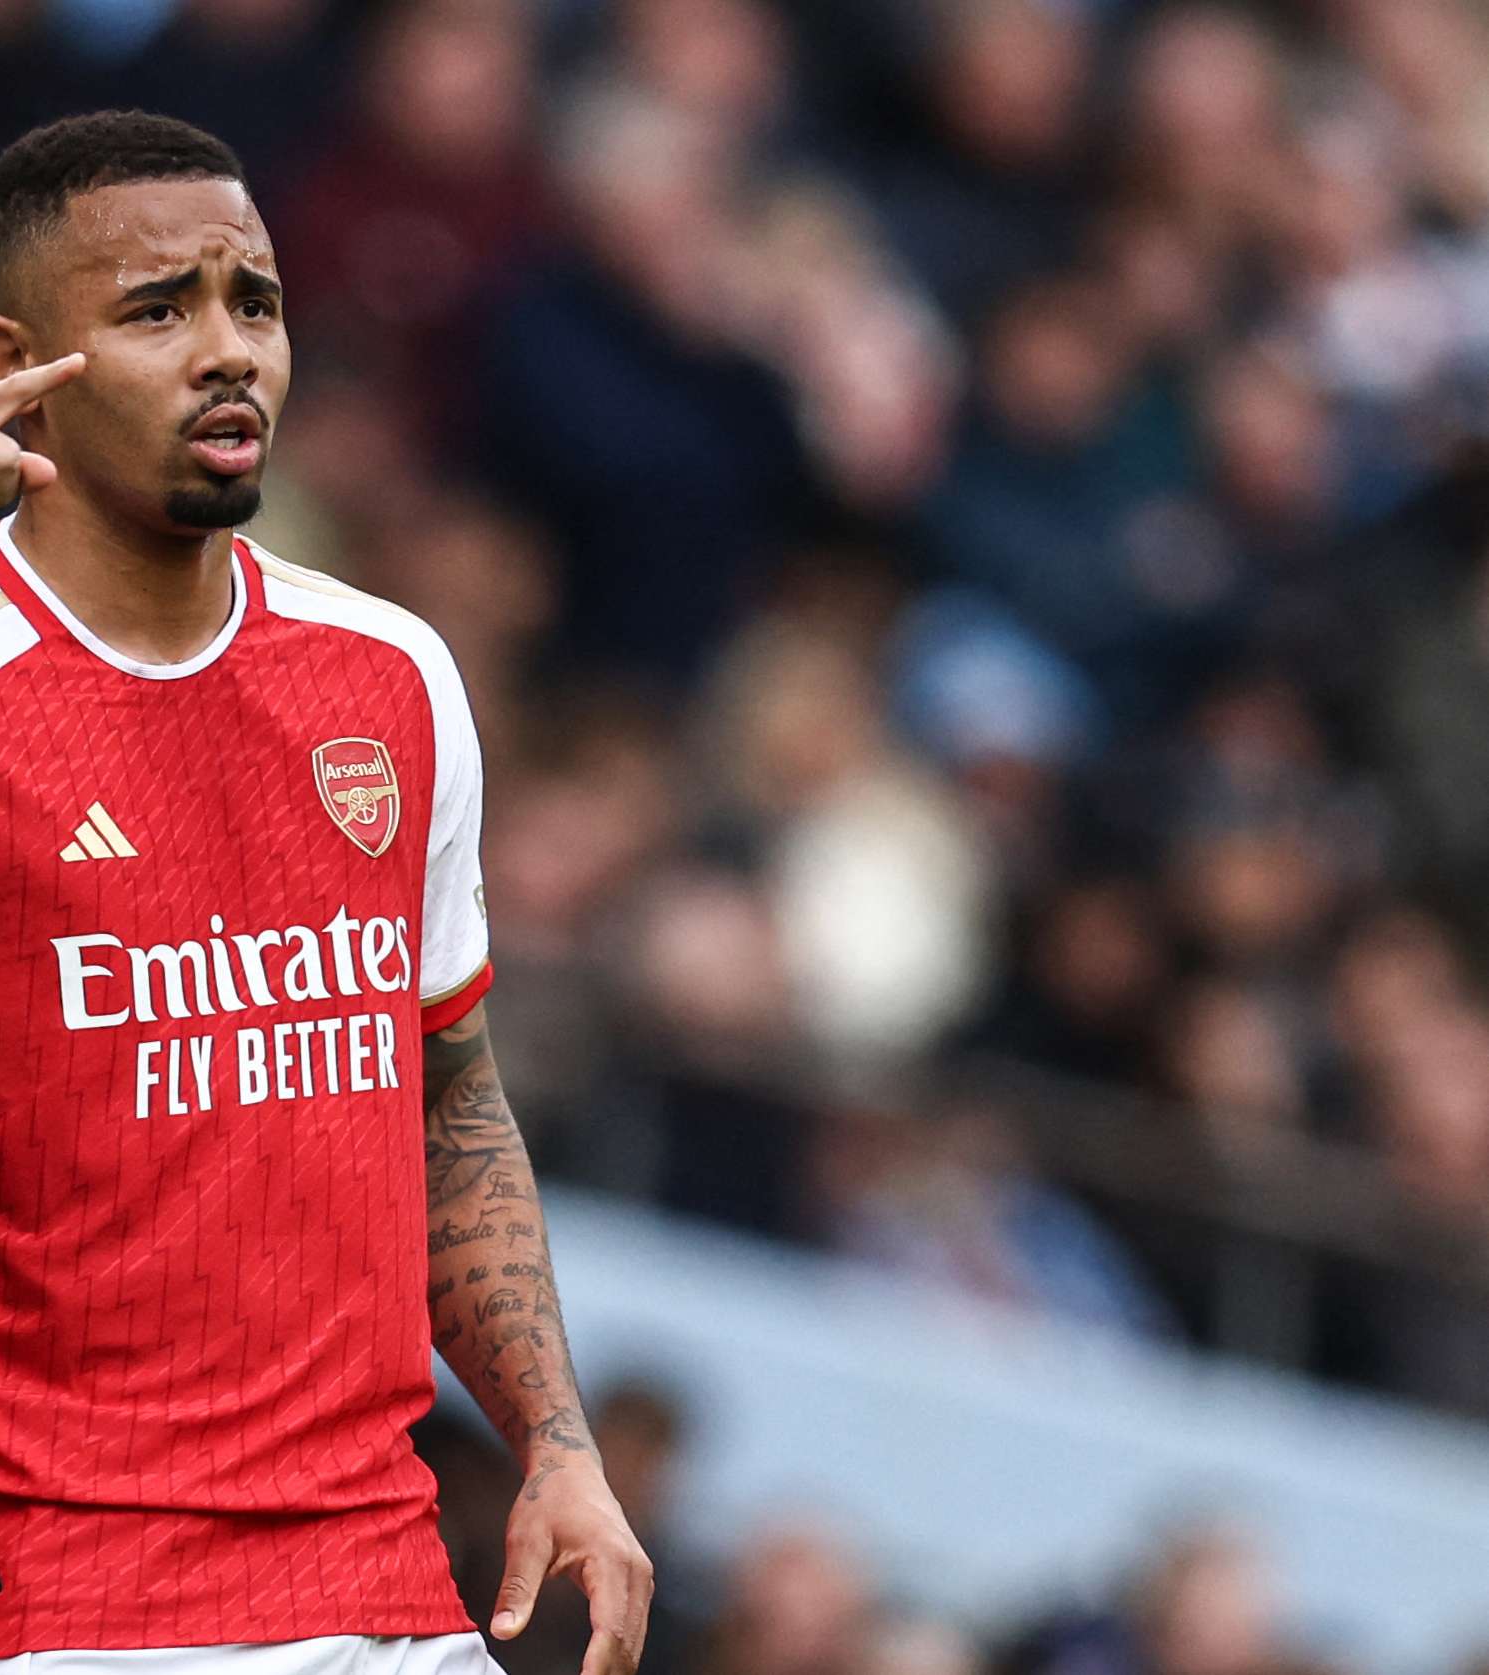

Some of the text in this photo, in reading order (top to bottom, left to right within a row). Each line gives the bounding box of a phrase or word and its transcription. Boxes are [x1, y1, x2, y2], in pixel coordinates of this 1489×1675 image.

[325, 757, 383, 781] Arsenal
[50, 904, 411, 1030] Emirates
[136, 1013, 400, 1119] FLY BETTER
